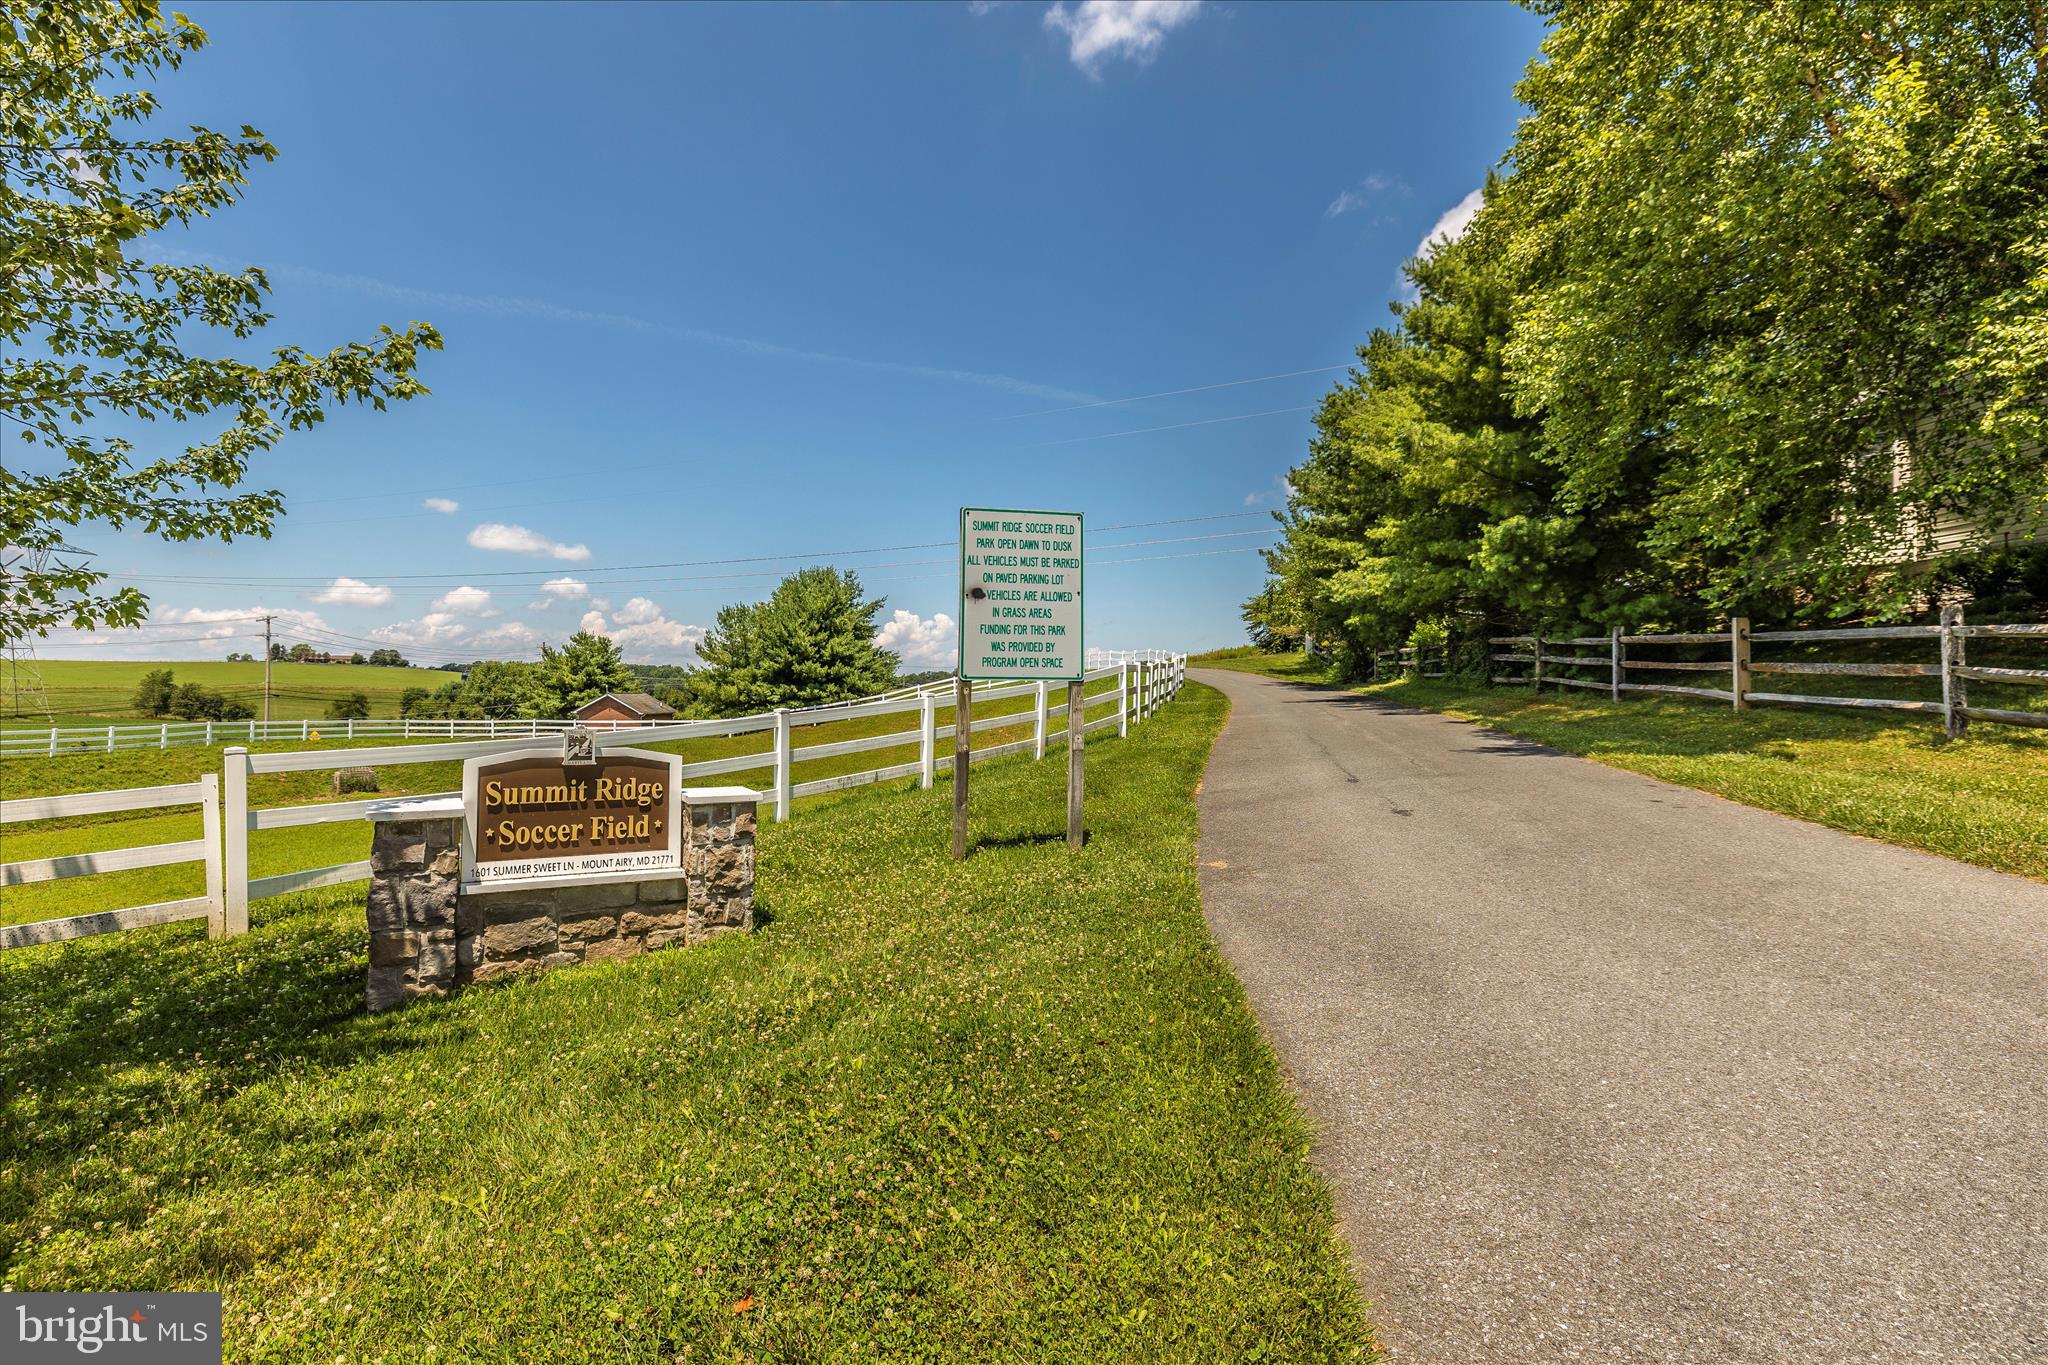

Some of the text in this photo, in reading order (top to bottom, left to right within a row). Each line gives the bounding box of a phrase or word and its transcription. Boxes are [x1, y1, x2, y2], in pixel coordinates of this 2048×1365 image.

[973, 521, 1074, 534] SUMMIT RIDGE SOCCER FIELD
[977, 539, 1072, 551] PARK OPEN DAWN TO DUSK
[967, 555, 1079, 568] ALL VEHICLES MUST BE PARKED
[983, 573, 1064, 584] ON PAVED PARKING LOT
[987, 590, 1020, 600] VEHICLES
[1024, 591, 1037, 600] ARE
[1040, 592, 1072, 602] ALLOWED
[993, 607, 1052, 618] IN GRASS AREAS
[980, 625, 1065, 635] FUNDING FOR THIS PARK
[991, 642, 1055, 652] WAS PROVIDED BY
[982, 657, 1063, 668] PROGRAM OPEN SPACE
[486, 778, 663, 806] Summit Ridge
[499, 815, 649, 846] Soccer Field
[472, 868, 490, 877] 1601
[493, 865, 531, 875] SUMMER
[534, 863, 561, 873] SWEET
[564, 862, 574, 871] LN
[582, 859, 613, 869] MOUNT
[615, 858, 634, 867] AIRY,
[637, 857, 650, 865] MD
[652, 855, 673, 864] 21771
